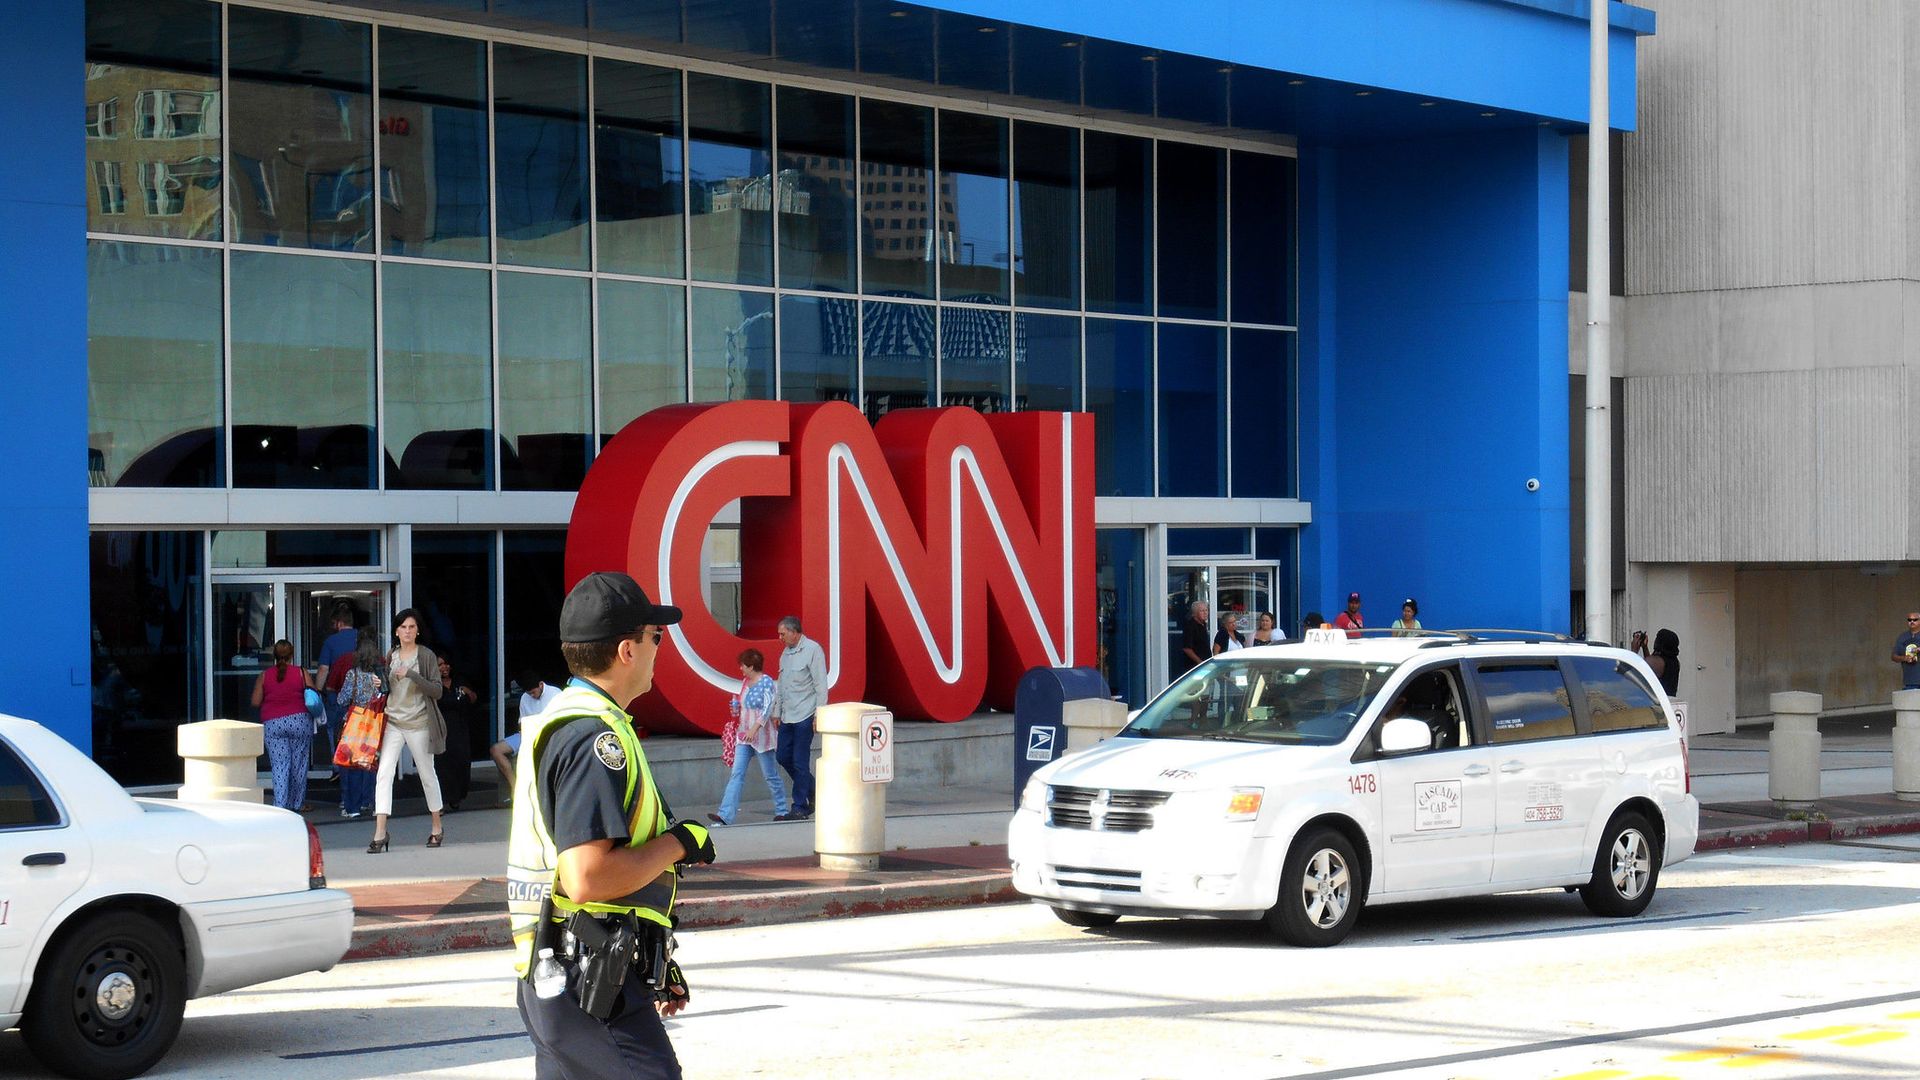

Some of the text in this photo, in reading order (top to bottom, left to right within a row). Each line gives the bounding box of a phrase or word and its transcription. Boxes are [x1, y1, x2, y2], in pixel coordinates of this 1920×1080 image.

[564, 400, 1096, 737] CNN
[1308, 631, 1336, 645] TAXI
[872, 755, 882, 765] NO
[864, 764, 890, 776] PARKING
[1158, 769, 1197, 780] 1478
[1348, 773, 1377, 794] 1478
[1418, 784, 1460, 807] CASCADE
[1430, 801, 1448, 814] CAB
[508, 880, 552, 901] OLICE
[0, 899, 9, 925] 1
